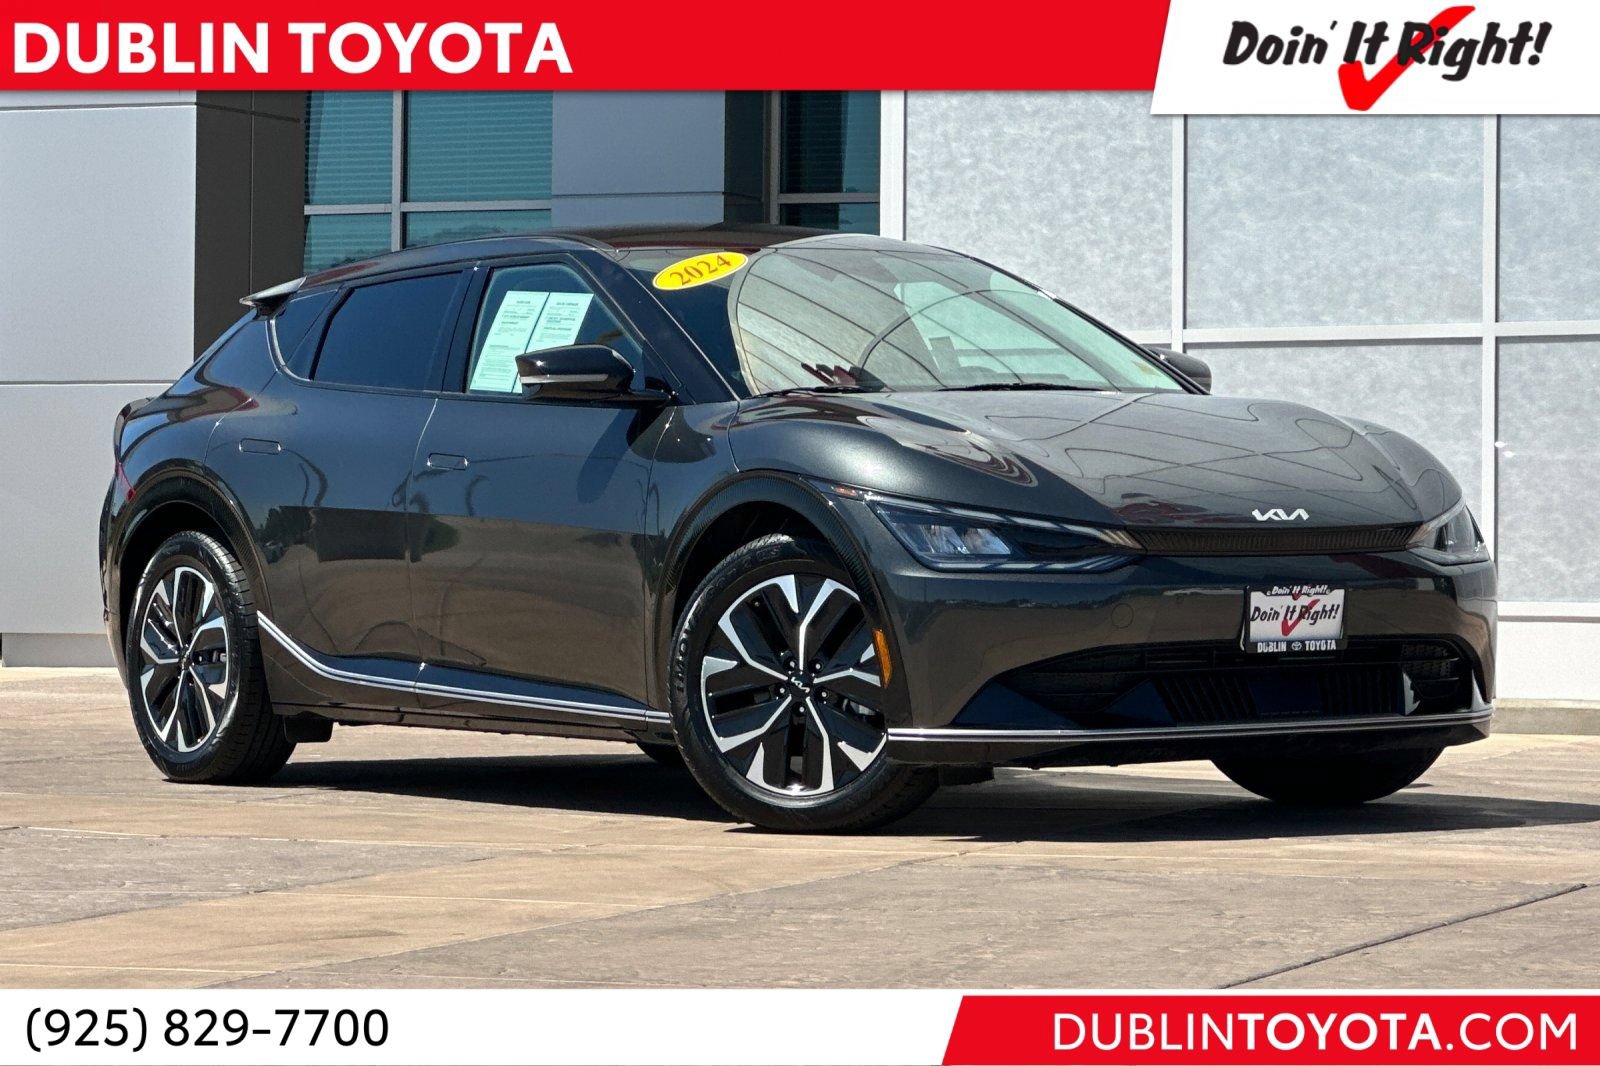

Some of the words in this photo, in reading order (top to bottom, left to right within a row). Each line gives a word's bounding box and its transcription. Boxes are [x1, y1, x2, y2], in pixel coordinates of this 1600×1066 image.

[669, 254, 732, 286] 2024
[1251, 508, 1310, 521] KIA
[1250, 604, 1284, 622] Doin'
[1284, 604, 1297, 621] It
[1298, 603, 1341, 626] Right!
[1257, 641, 1287, 653] DUBLIN
[1305, 639, 1337, 652] TOYOTA
